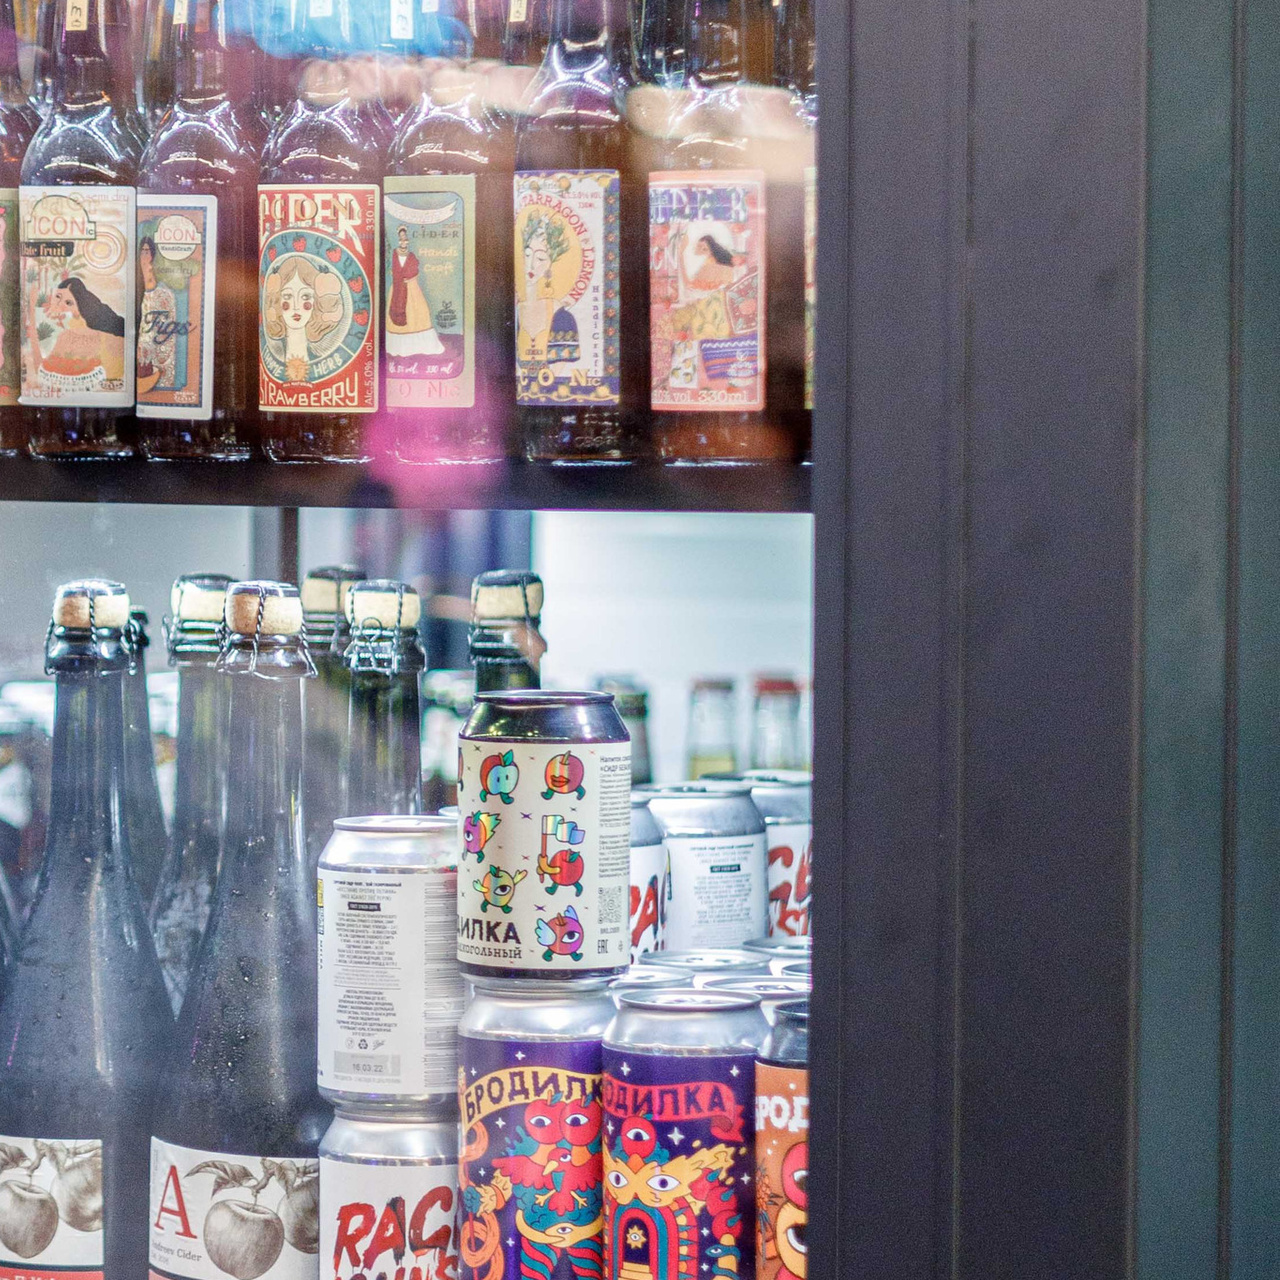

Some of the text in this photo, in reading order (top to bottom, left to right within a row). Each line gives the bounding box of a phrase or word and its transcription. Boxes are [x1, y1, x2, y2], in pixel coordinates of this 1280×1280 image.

[366, 209, 375, 232] 330
[39, 242, 66, 256] fruit
[520, 192, 588, 236] TARRAGON
[568, 246, 595, 302] LEMON
[424, 263, 455, 275] Craft
[142, 310, 196, 345] Figs
[313, 356, 344, 378] HERB
[260, 370, 360, 407] STRAWBERRY
[154, 1164, 198, 1240] A
[176, 1248, 203, 1263] Cider
